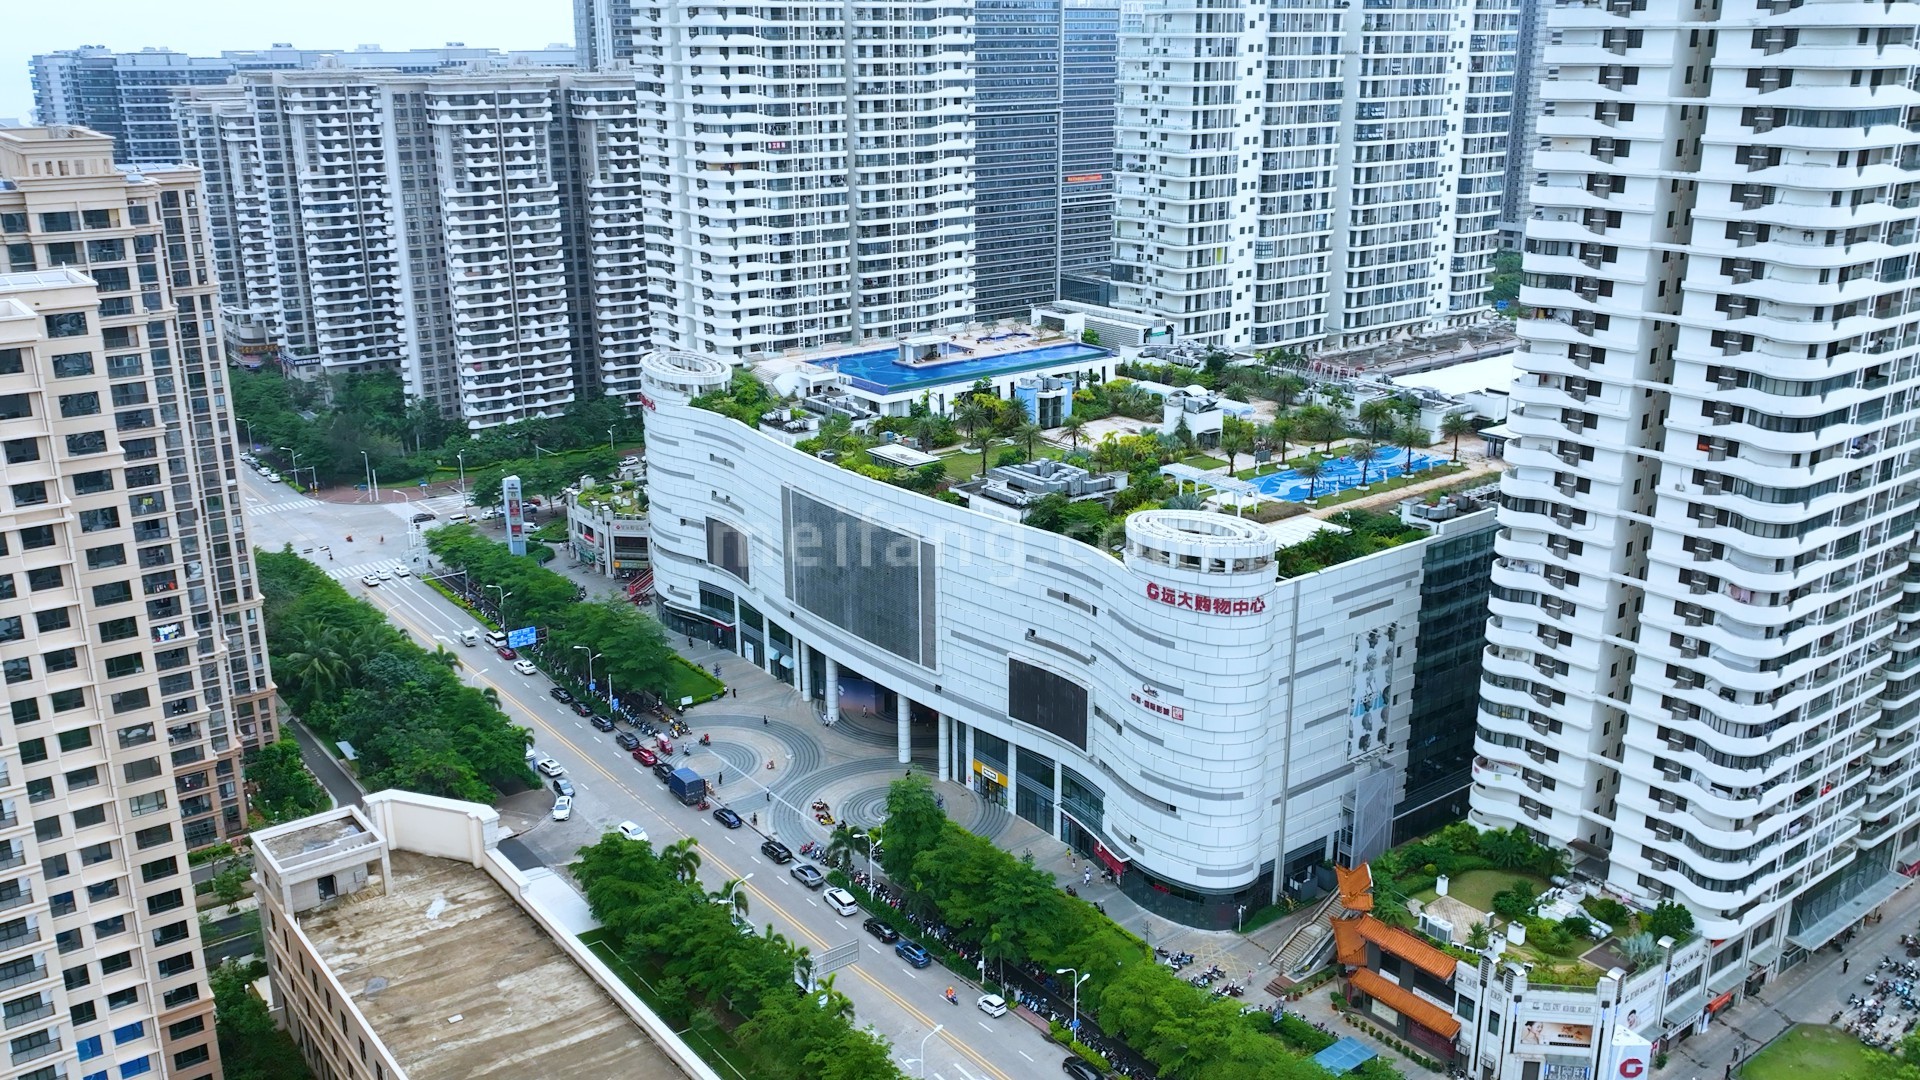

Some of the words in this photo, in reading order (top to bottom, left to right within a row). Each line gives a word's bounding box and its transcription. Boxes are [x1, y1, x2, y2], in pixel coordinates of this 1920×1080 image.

[1161, 586, 1266, 616] 远大购物中心
